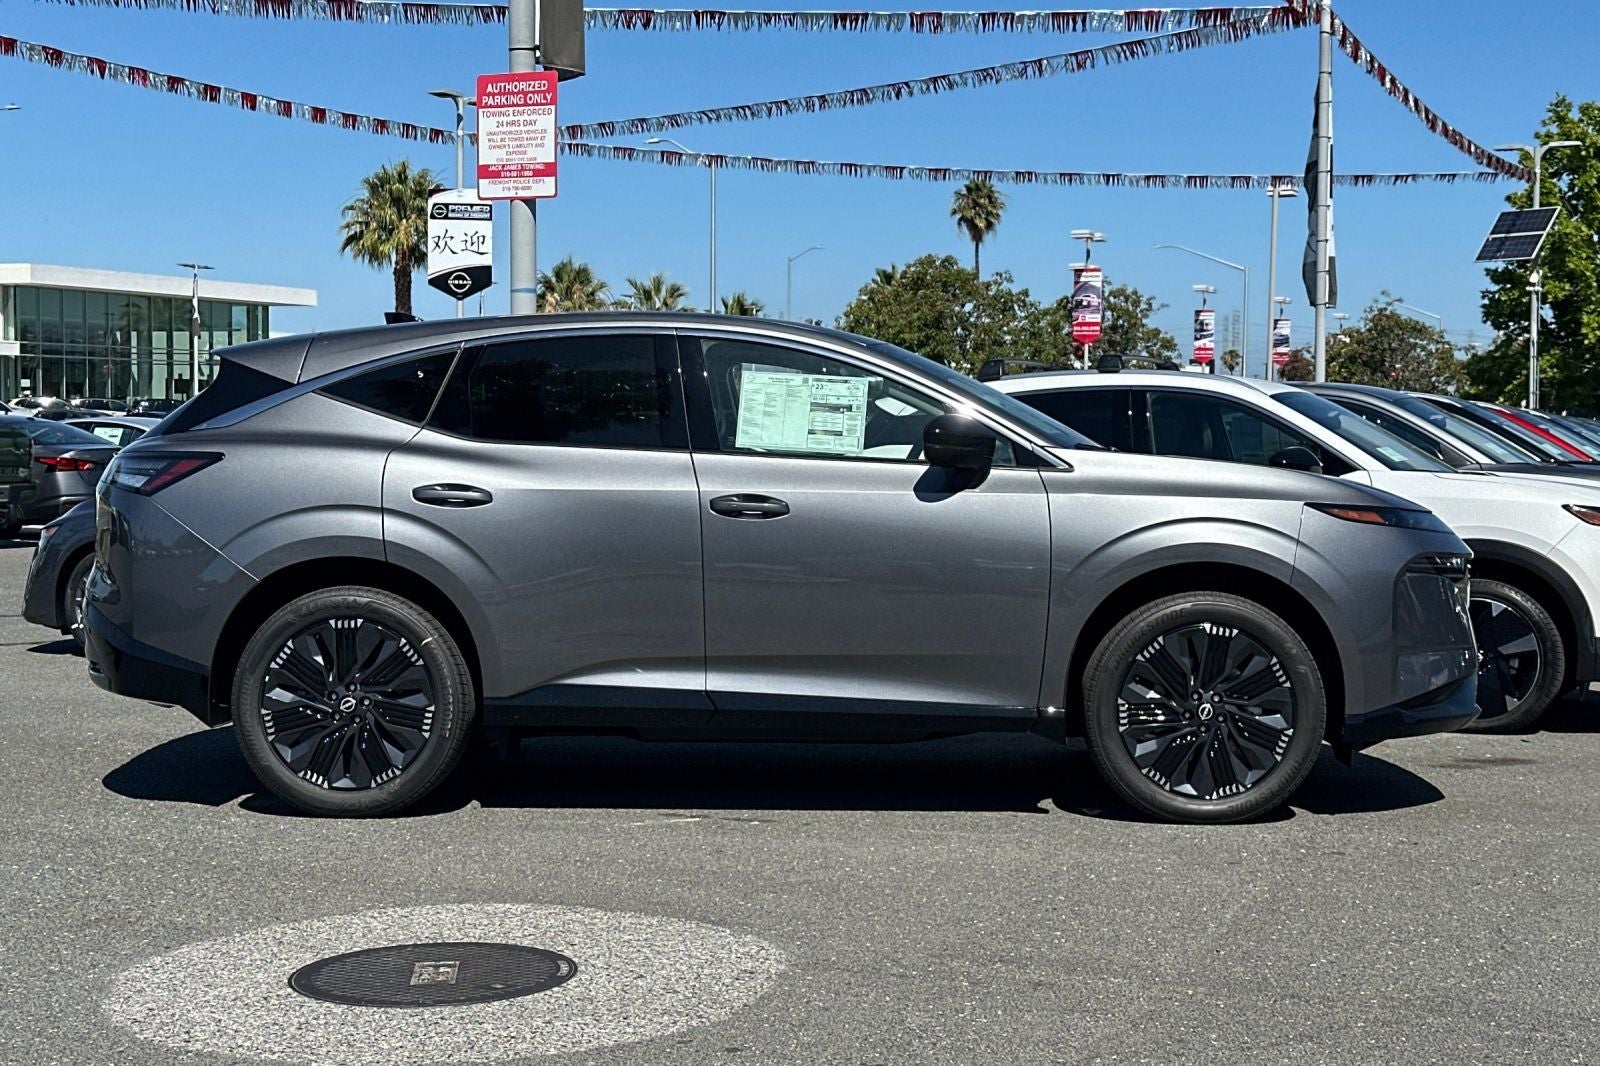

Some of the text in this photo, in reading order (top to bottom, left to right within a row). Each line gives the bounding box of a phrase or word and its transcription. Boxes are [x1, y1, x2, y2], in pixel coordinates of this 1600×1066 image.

[486, 80, 548, 93] AUTHORIZED
[482, 93, 552, 106] PARKING ONLY
[482, 108, 552, 118] TOWING ENFORCED
[523, 119, 537, 127] DAY
[448, 205, 490, 213] PREMIER
[431, 228, 490, 256] 欢迎
[1114, 608, 1185, 673] BRIDGESTONE
